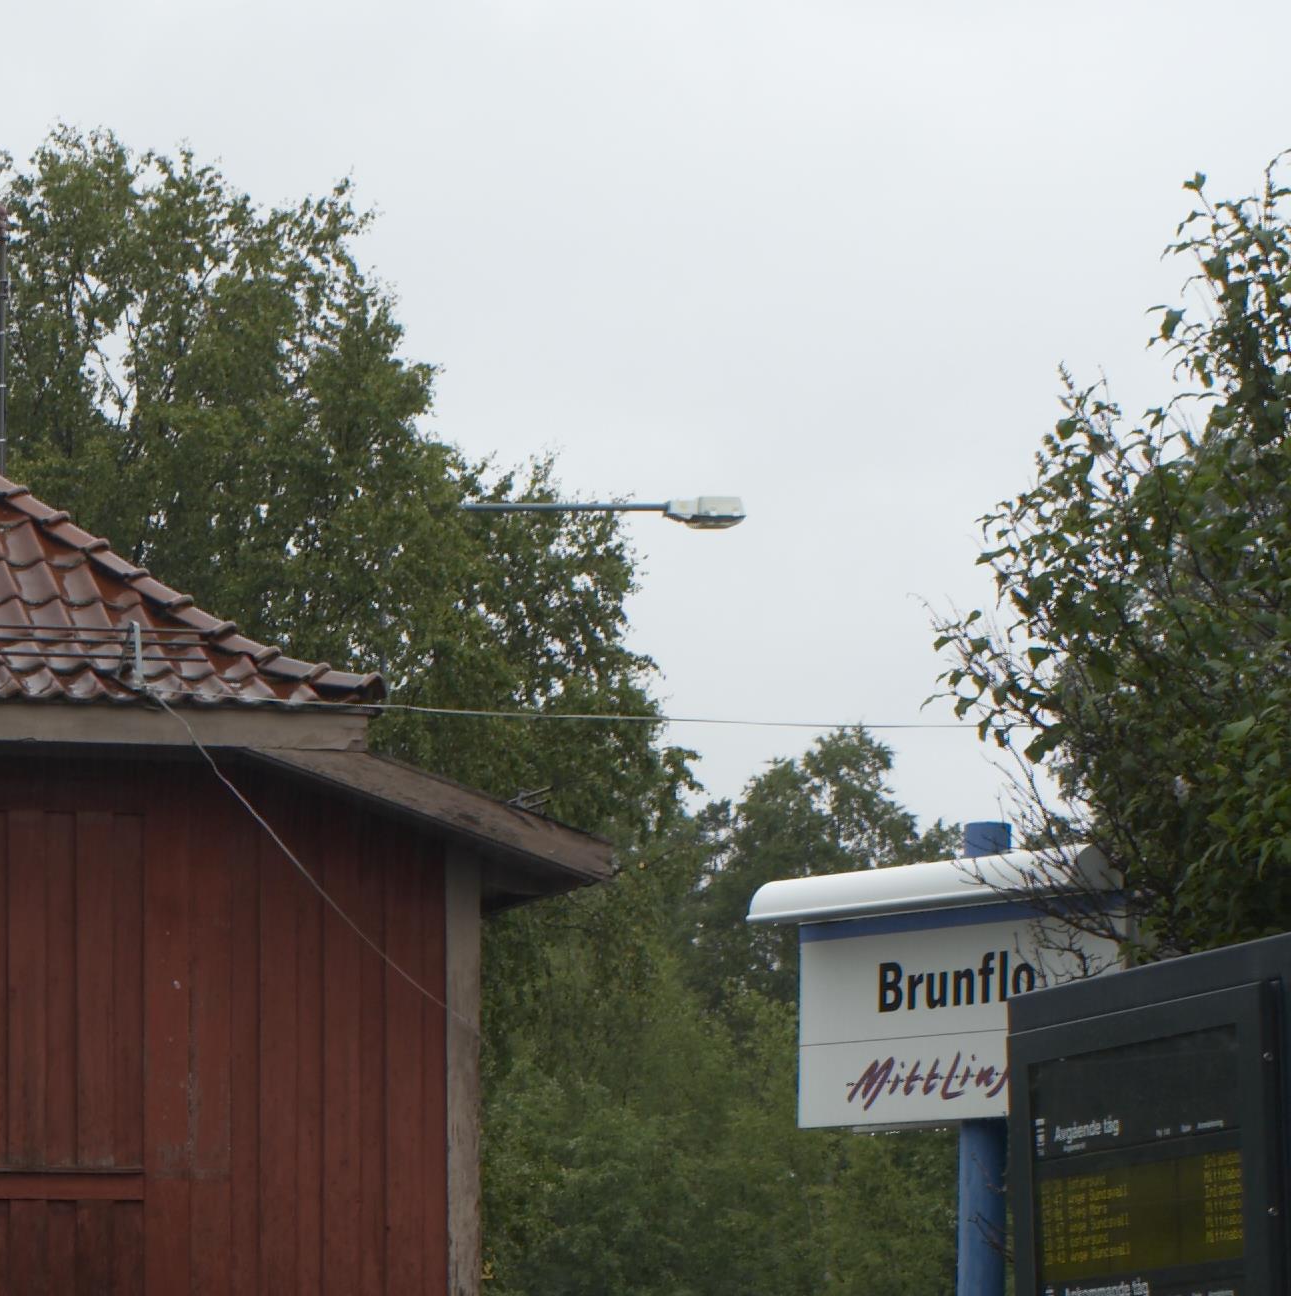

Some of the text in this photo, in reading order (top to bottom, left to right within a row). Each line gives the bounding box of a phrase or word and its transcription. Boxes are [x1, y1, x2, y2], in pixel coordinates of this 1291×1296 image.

[878, 951, 1036, 1013] Brunflo
[1053, 1115, 1121, 1144] Avgående tåg
